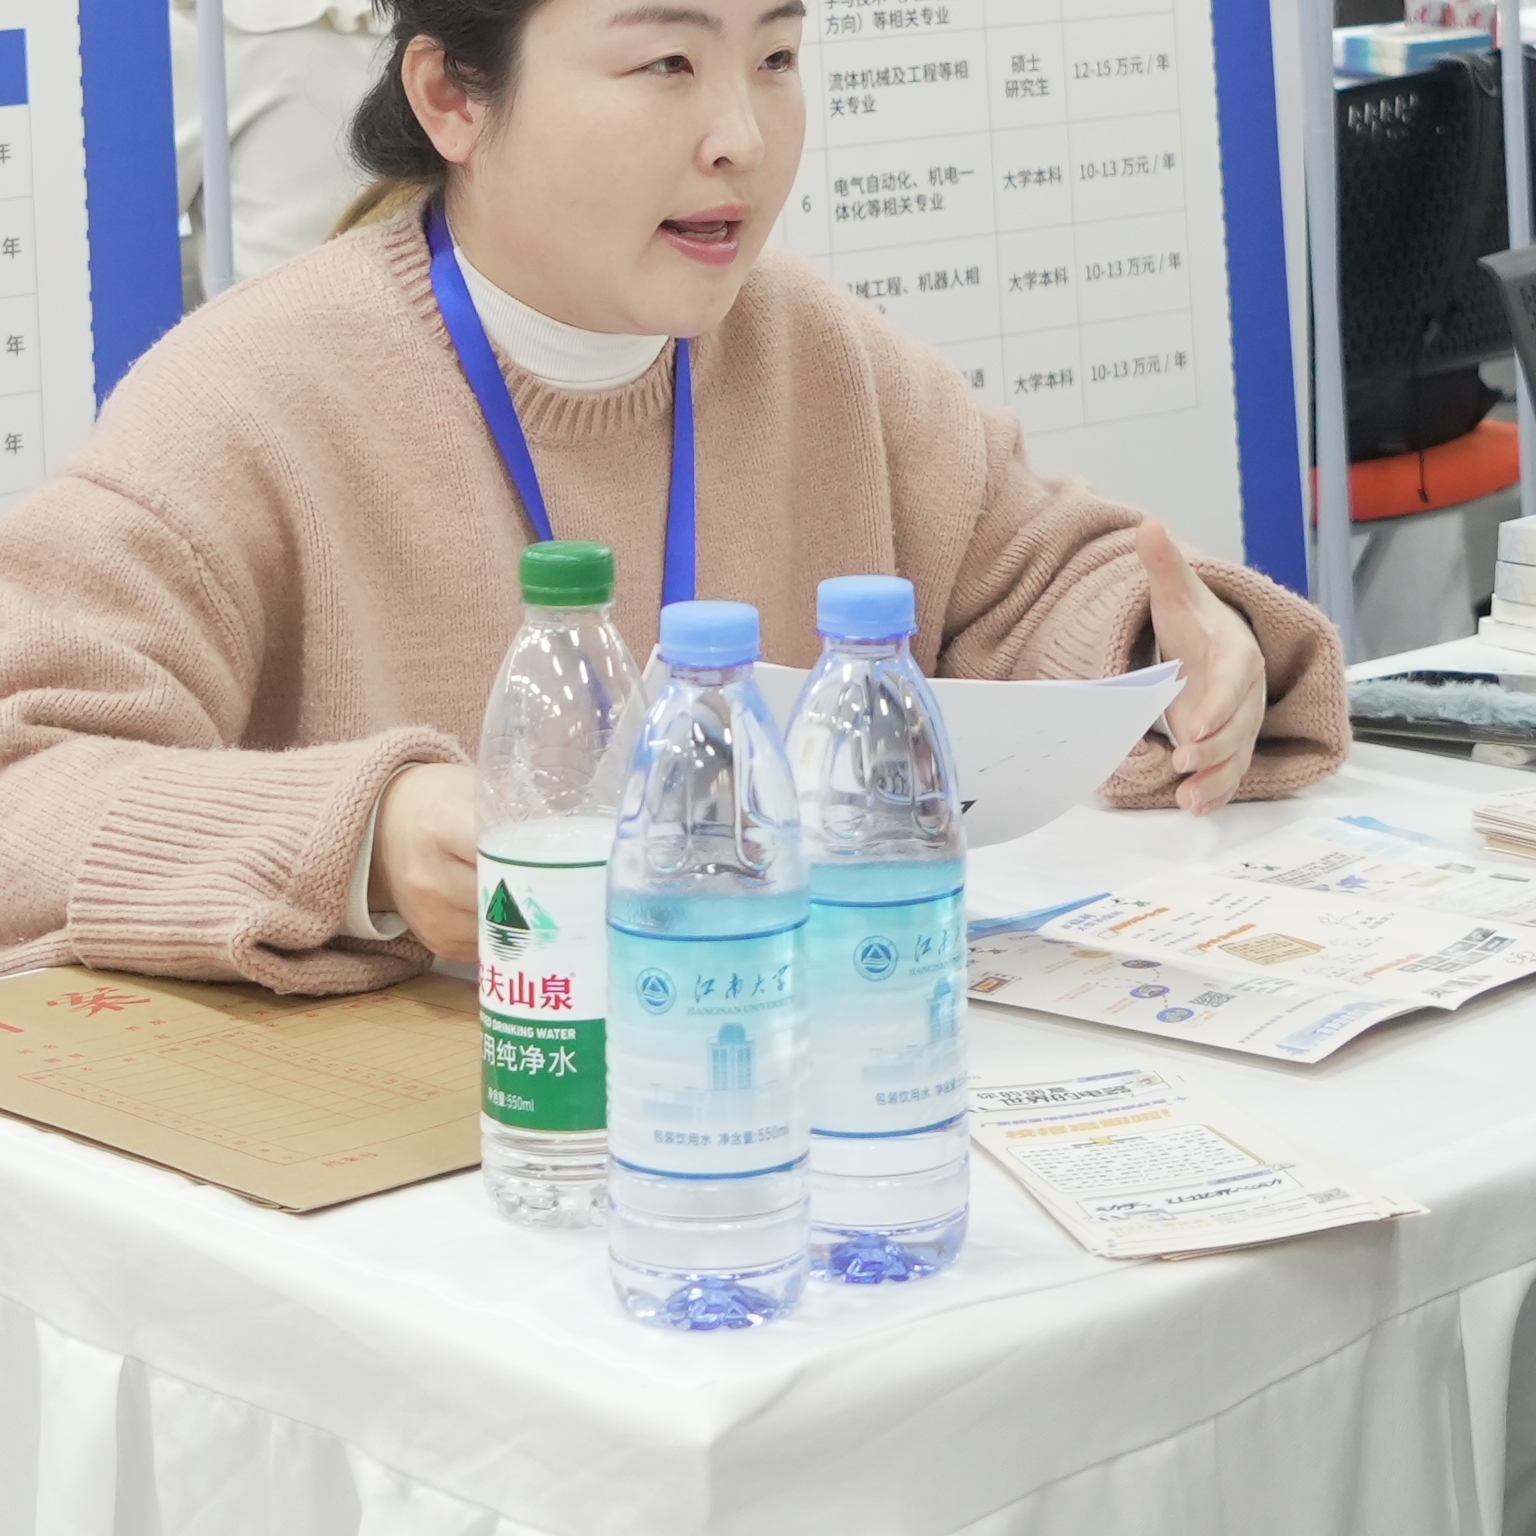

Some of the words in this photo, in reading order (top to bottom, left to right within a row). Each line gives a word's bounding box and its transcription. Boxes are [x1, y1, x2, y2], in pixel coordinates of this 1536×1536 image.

[3, 237, 21, 258] 年
[480, 1032, 578, 1077] 用纯净水
